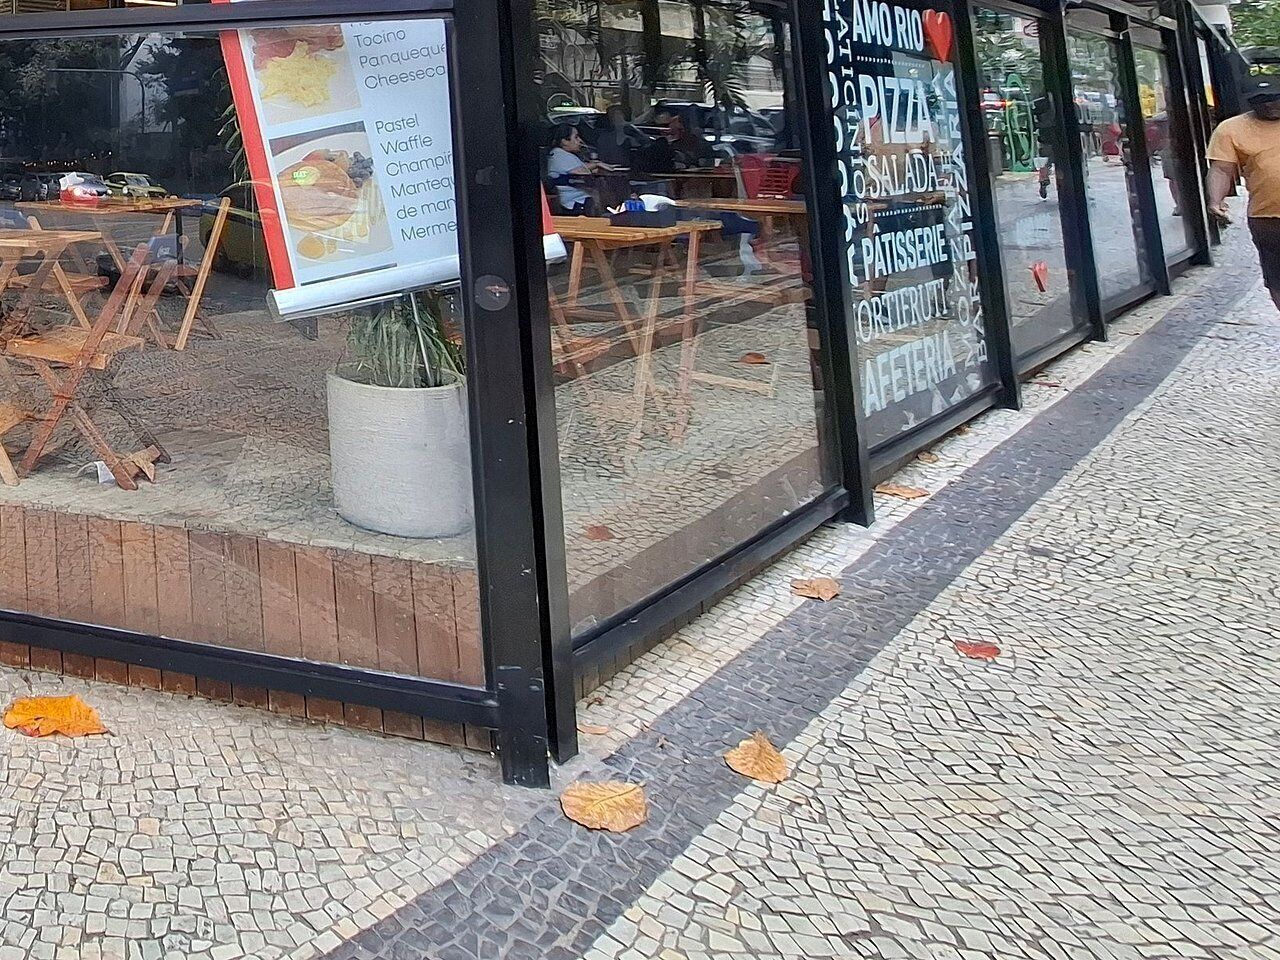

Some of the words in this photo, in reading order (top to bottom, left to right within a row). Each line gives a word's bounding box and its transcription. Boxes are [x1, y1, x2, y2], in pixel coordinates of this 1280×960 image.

[353, 29, 406, 48] Tocino
[894, 6, 924, 52] RIO
[375, 113, 419, 134] Pastel
[858, 74, 936, 144] PIZZA
[380, 135, 433, 155] Waffle
[865, 148, 939, 199] SALADA
[396, 205, 418, 220] de
[401, 220, 458, 242] Merme
[861, 223, 948, 281] PÂTISSERIE
[970, 276, 989, 362] BAR
[860, 330, 957, 417] AFETERIA
